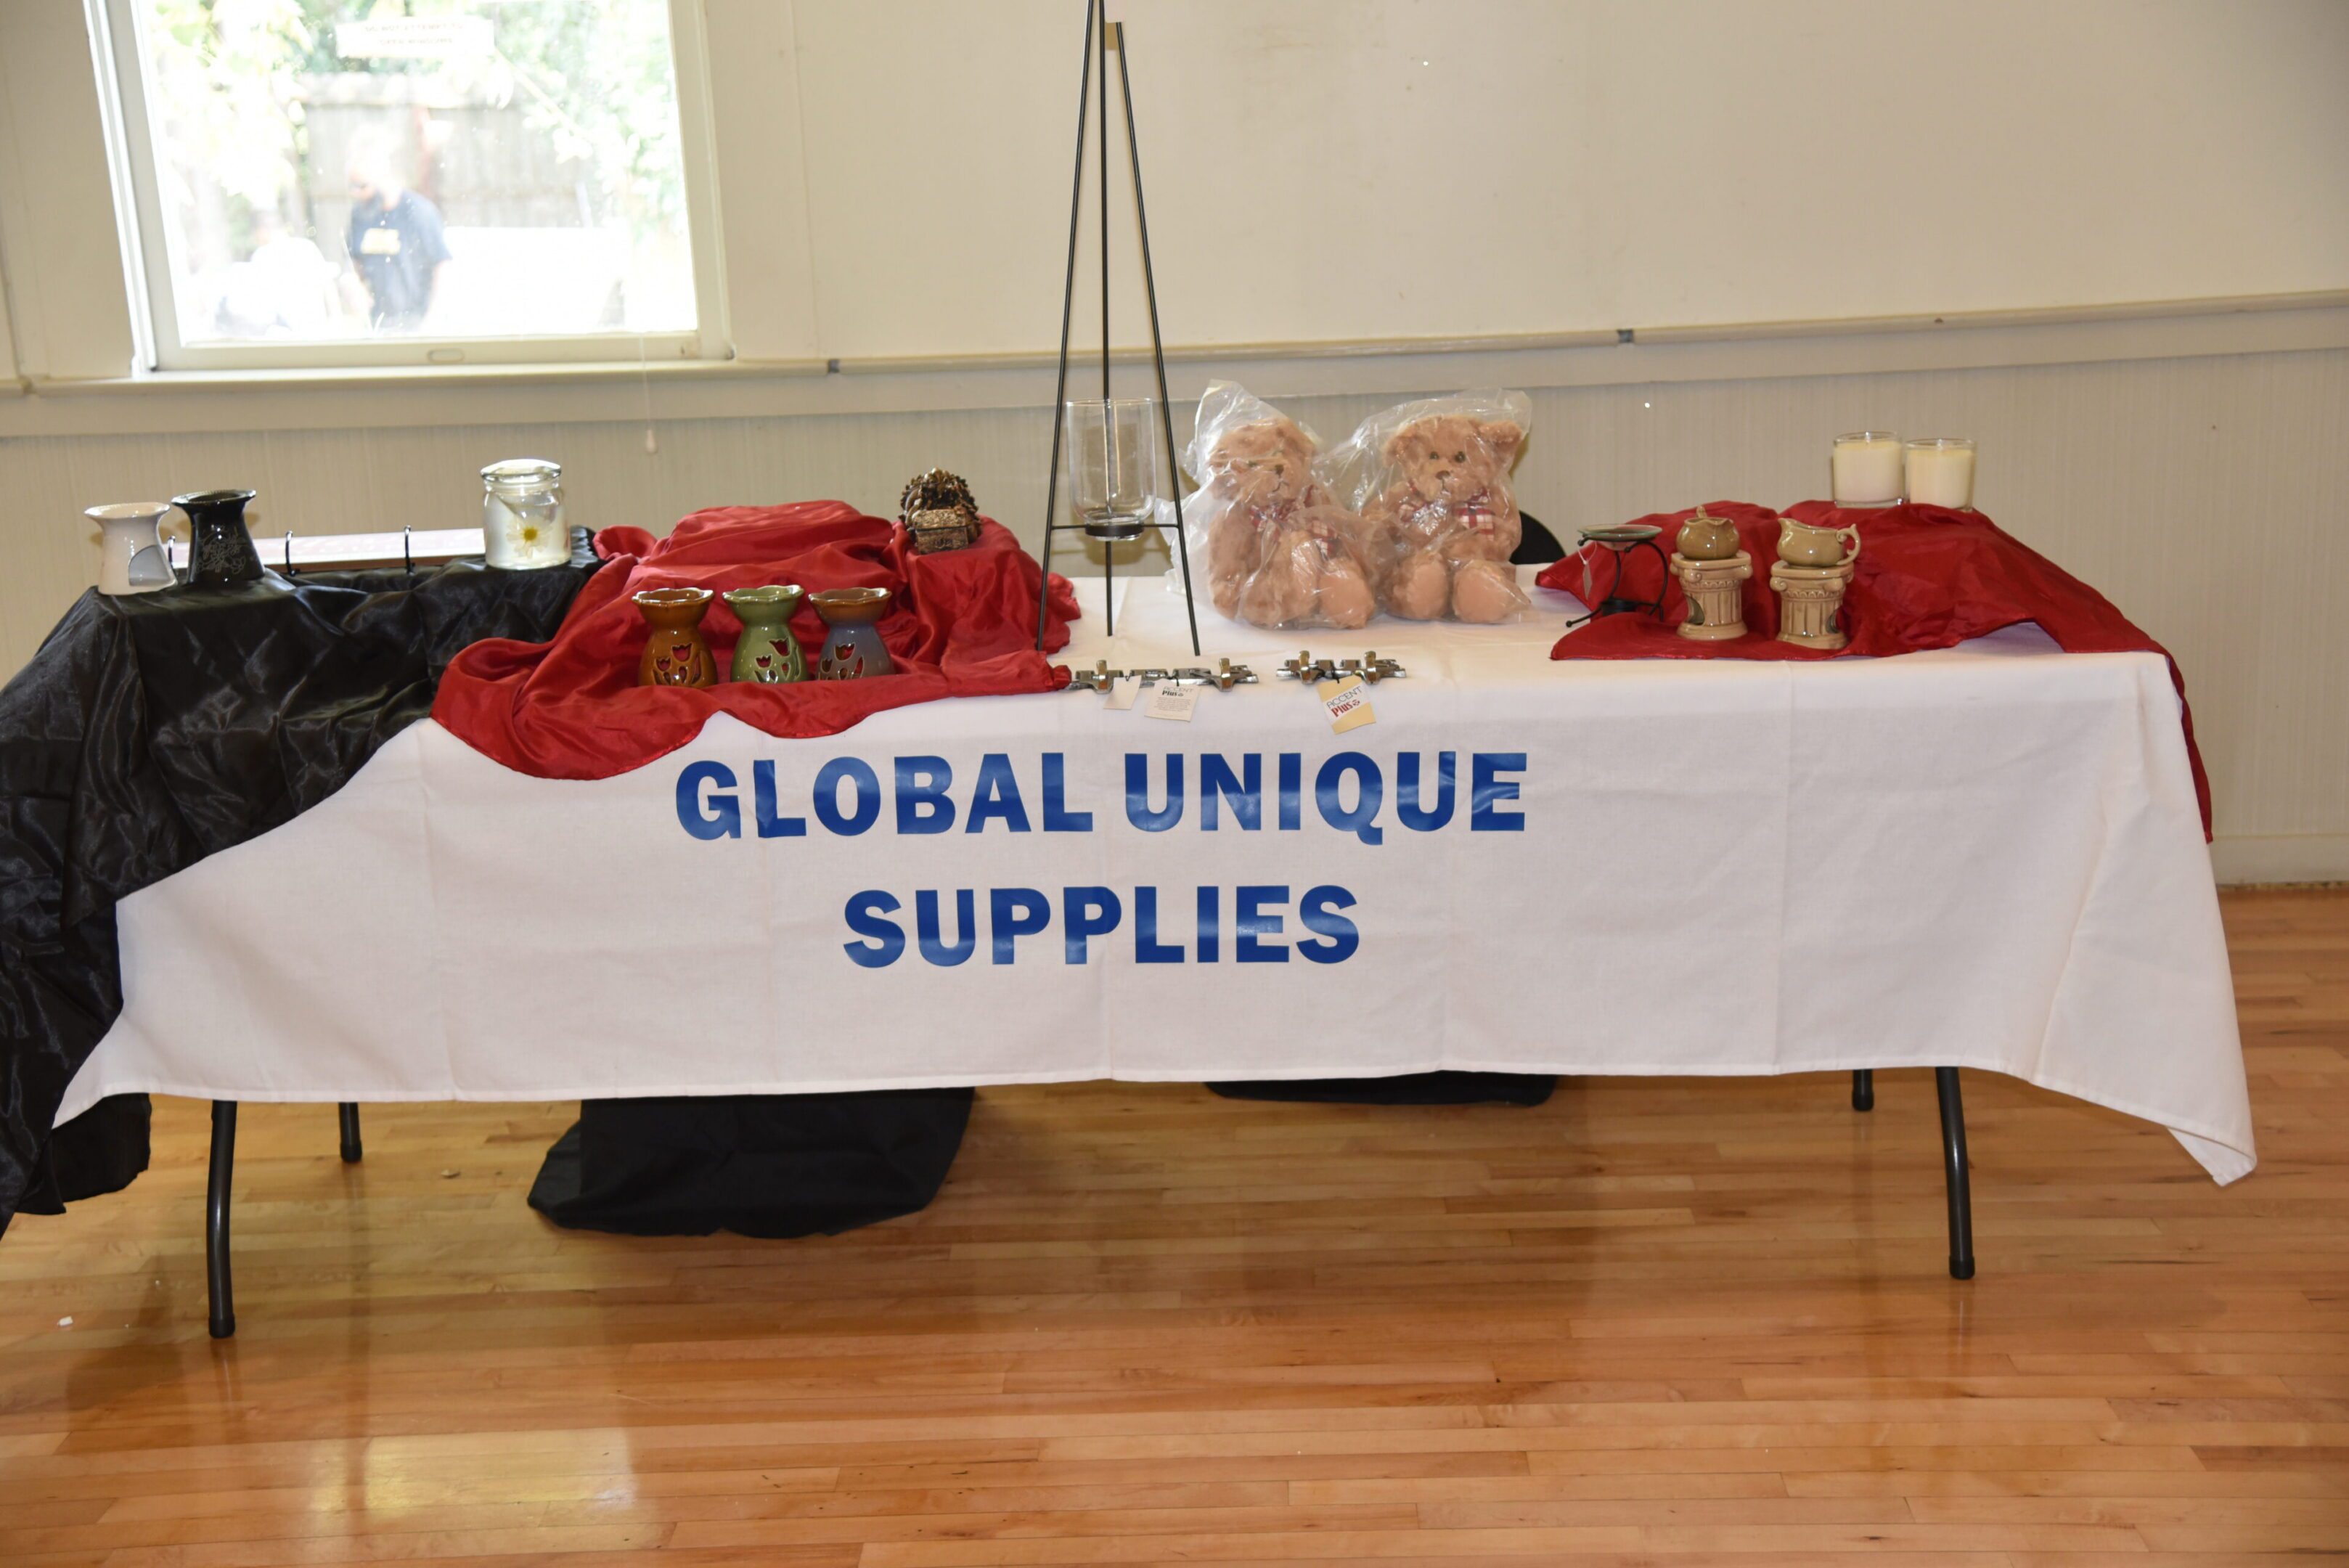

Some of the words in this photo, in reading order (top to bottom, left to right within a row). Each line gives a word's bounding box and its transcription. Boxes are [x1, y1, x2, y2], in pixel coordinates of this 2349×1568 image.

[1326, 685, 1363, 709] ACCENT
[1331, 701, 1354, 717] Plus
[677, 754, 1093, 840] GLOBAL
[1126, 752, 1527, 845] UNIQUE
[845, 886, 1359, 968] SUPPLIES
